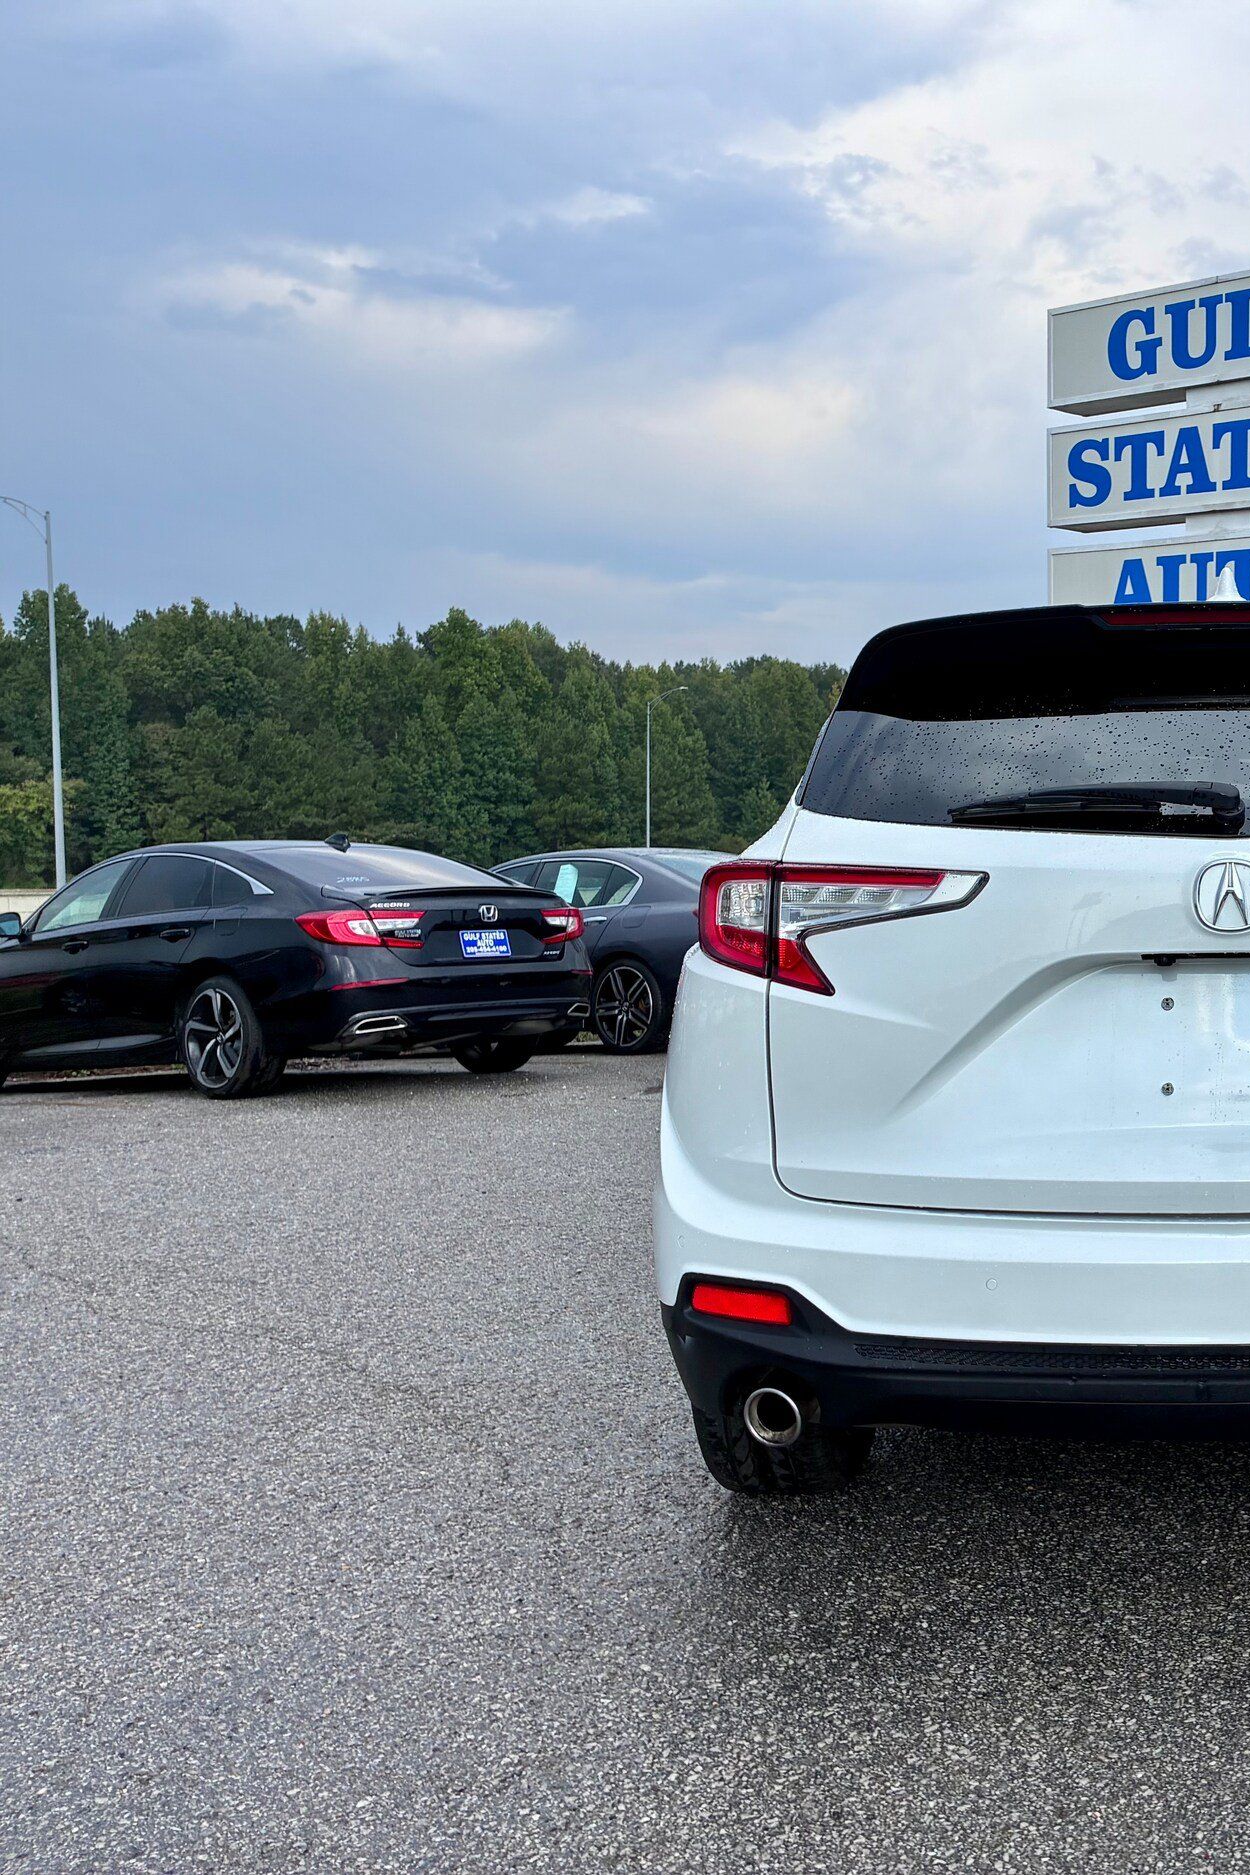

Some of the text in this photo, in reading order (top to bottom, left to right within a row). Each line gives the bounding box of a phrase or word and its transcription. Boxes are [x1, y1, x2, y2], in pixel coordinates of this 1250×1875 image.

[463, 931, 505, 941] GULF STATES
[477, 939, 494, 947] AUTO
